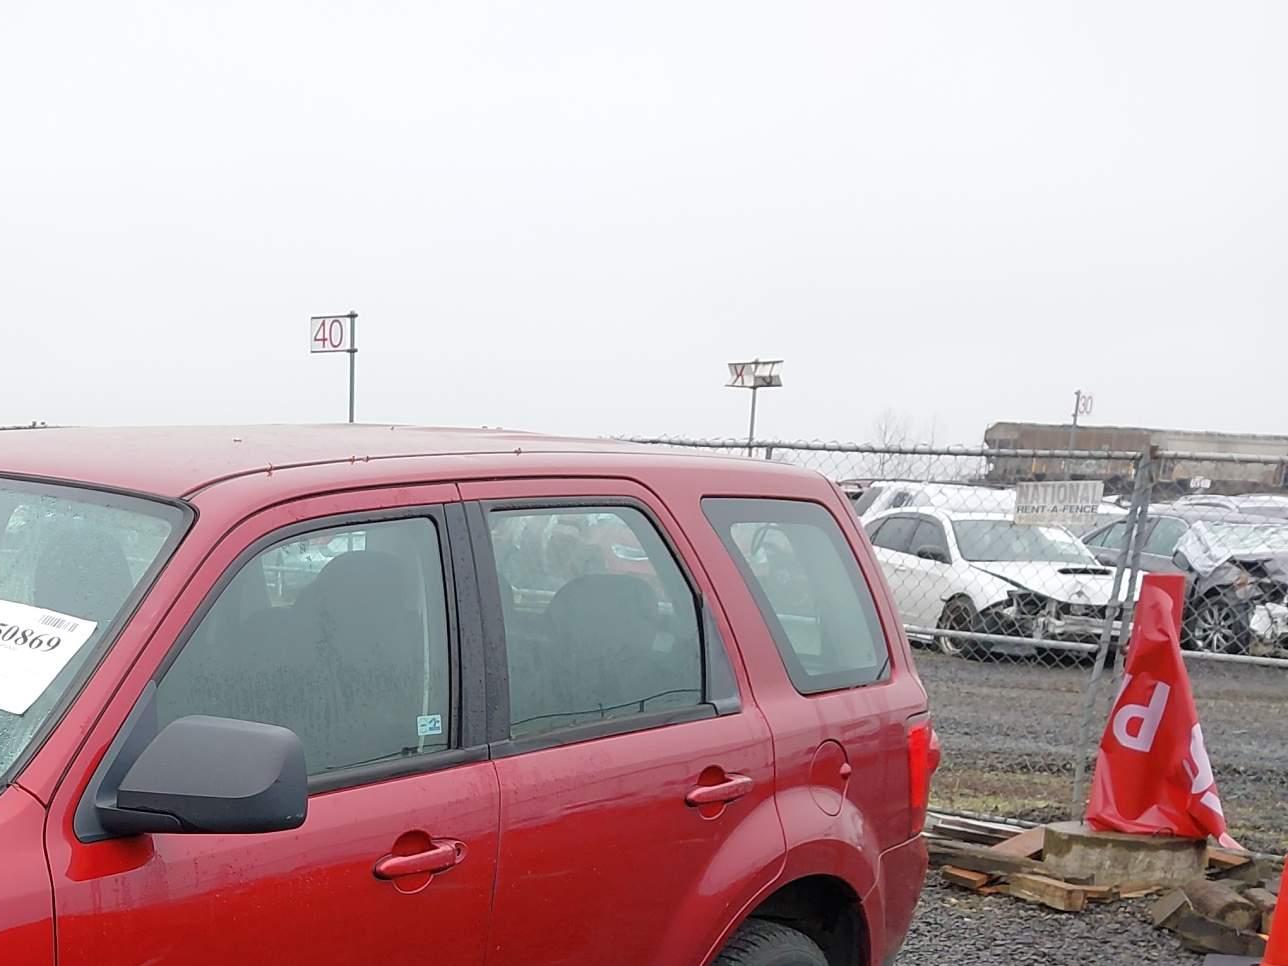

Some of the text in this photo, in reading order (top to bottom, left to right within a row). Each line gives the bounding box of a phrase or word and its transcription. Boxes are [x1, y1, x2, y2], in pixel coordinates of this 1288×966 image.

[313, 319, 344, 349] 40
[1078, 395, 1093, 415] 30
[1017, 482, 1101, 504] NATIONAL
[1016, 504, 1099, 514] RENT-A-FENCE
